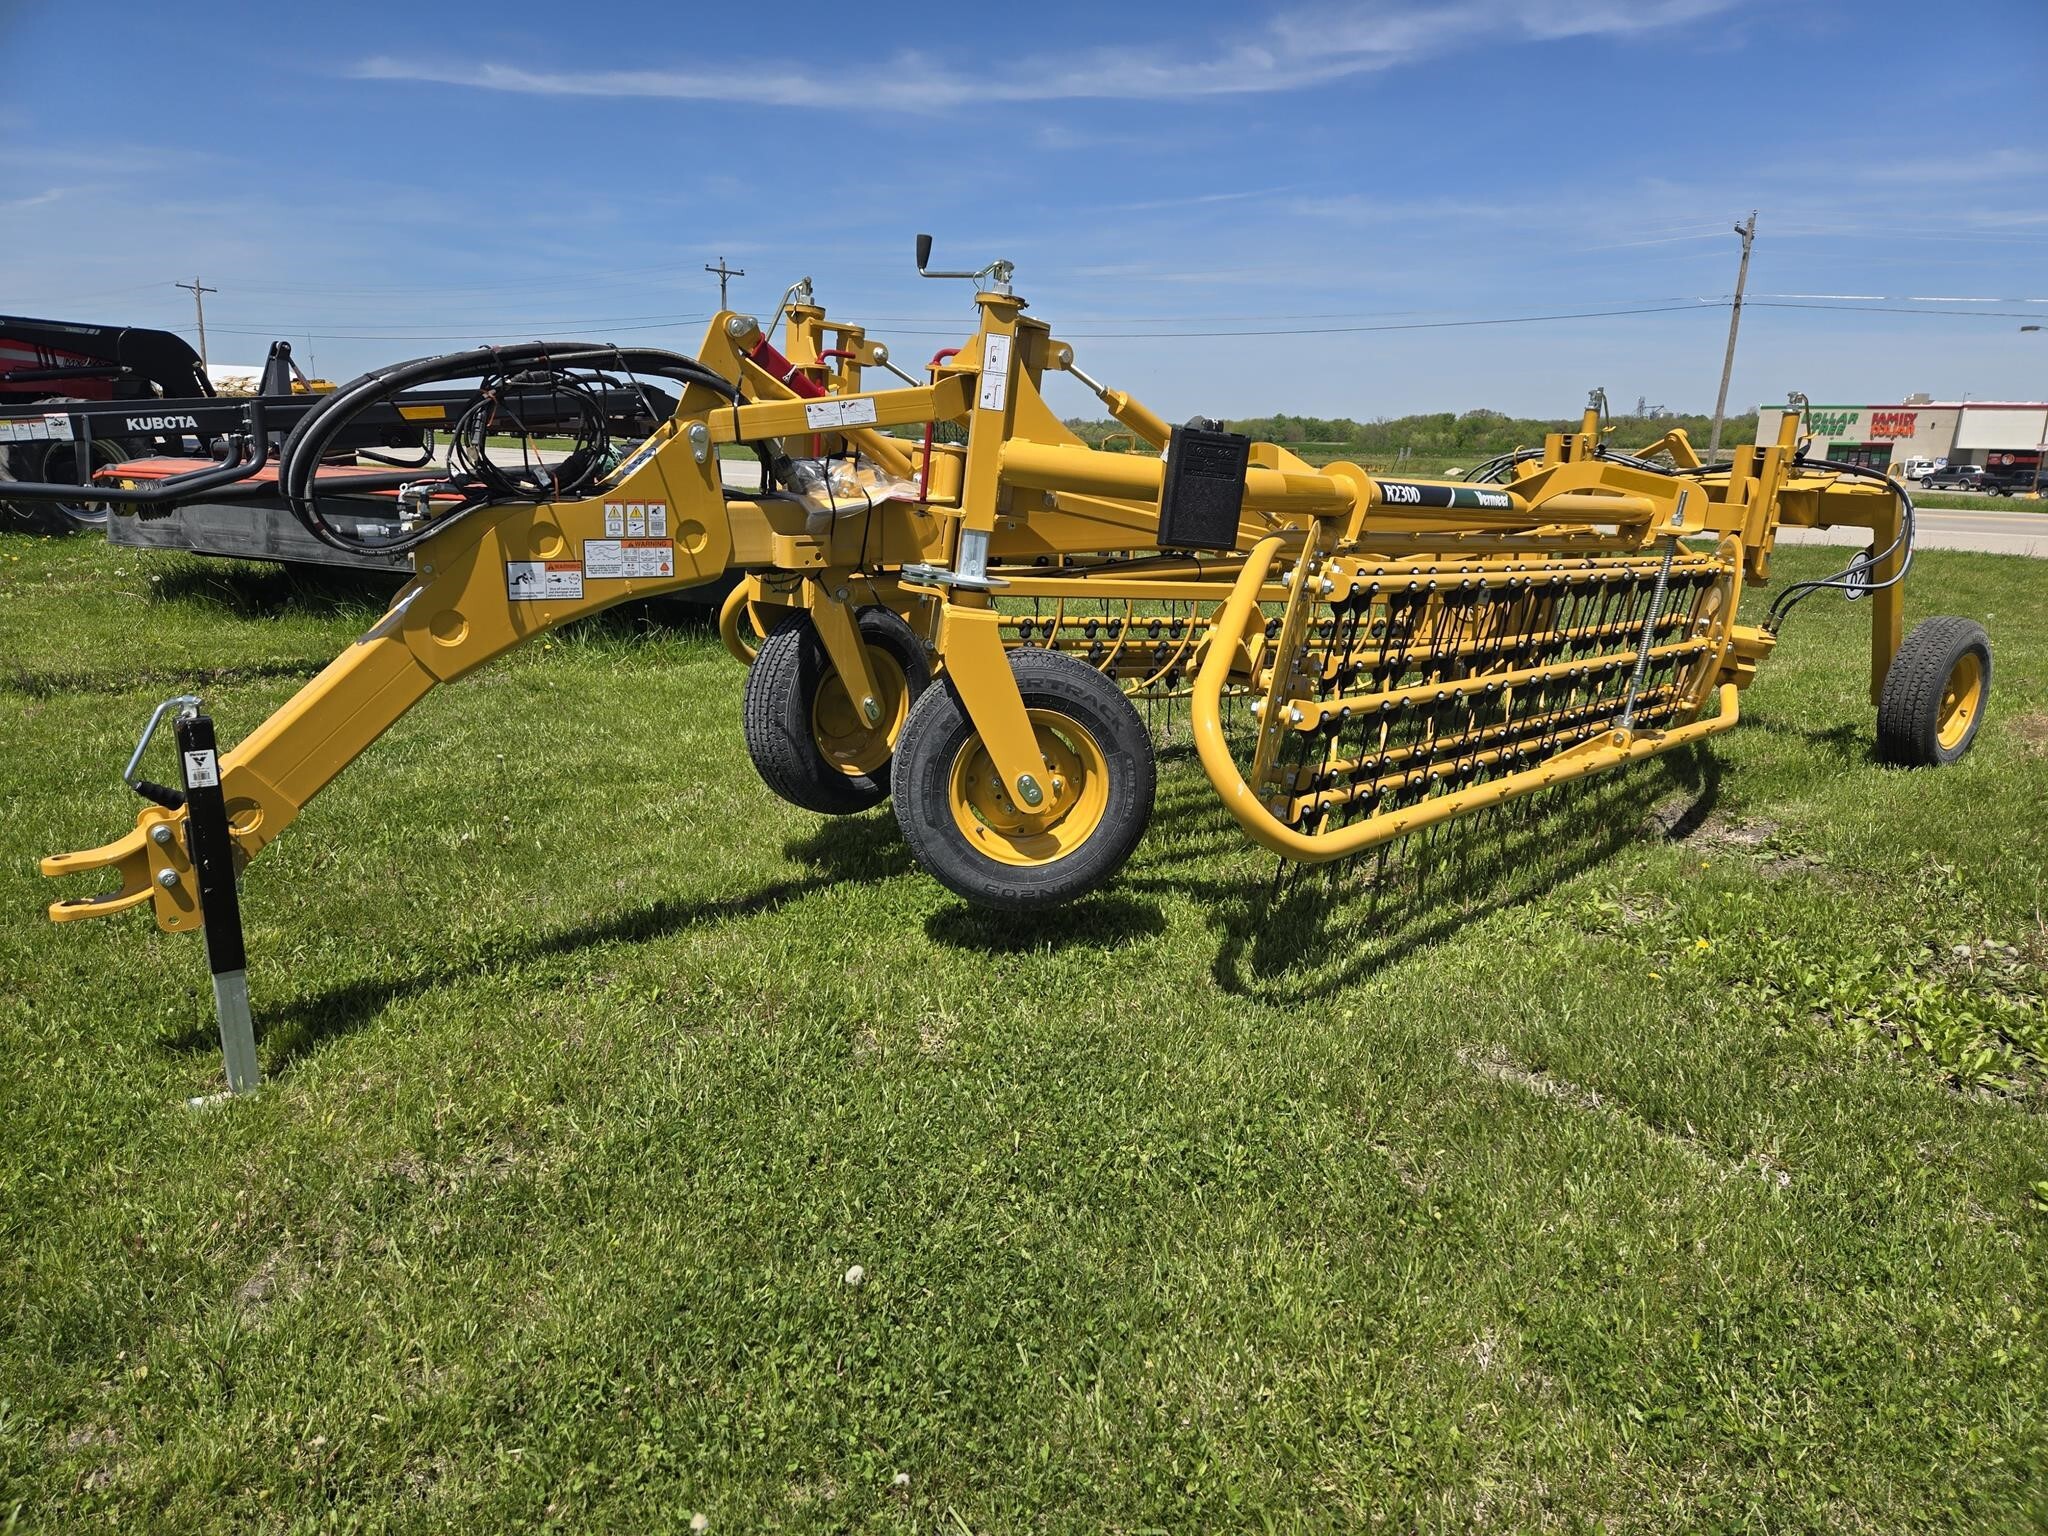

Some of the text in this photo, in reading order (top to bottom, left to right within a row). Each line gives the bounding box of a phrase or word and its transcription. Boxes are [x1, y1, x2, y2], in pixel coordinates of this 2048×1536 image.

[126, 415, 198, 431] KUBOTA
[1801, 412, 1859, 425] DOLLAR
[1871, 412, 1918, 426] FAMILY
[1810, 424, 1847, 436] TREE
[1383, 484, 1509, 507] R2300 Vermeer
[634, 540, 667, 548] WARNING
